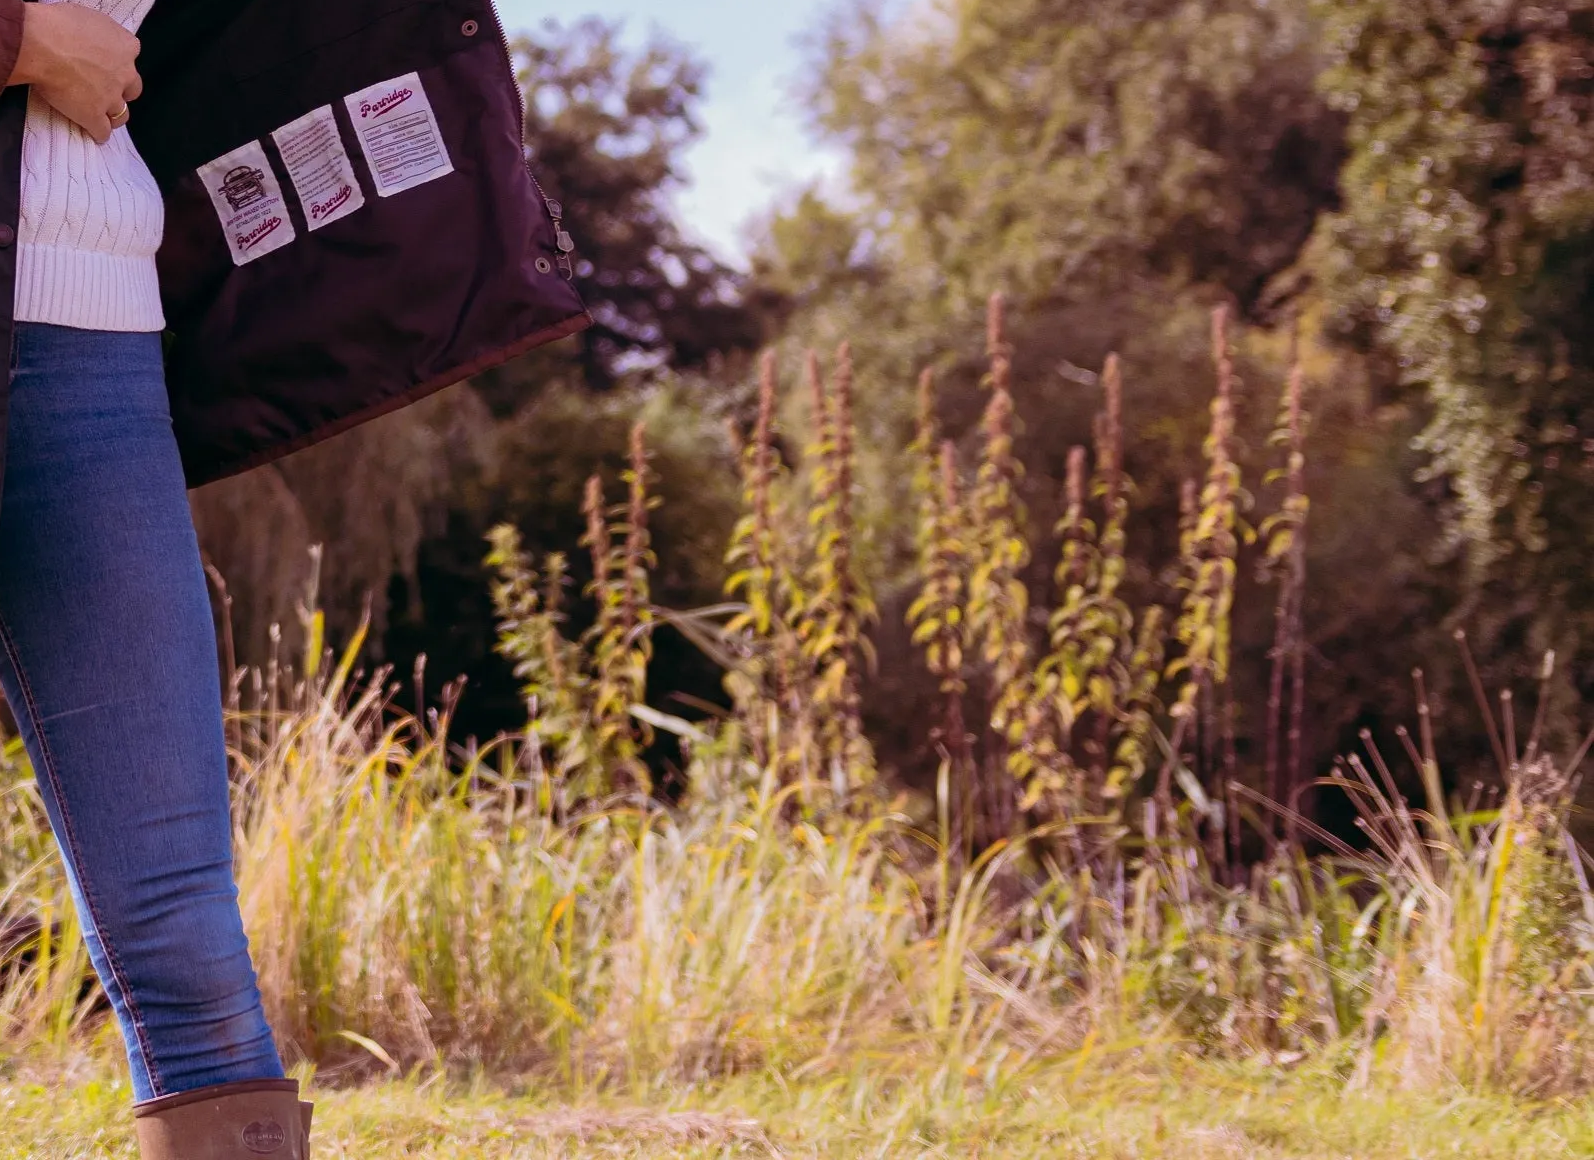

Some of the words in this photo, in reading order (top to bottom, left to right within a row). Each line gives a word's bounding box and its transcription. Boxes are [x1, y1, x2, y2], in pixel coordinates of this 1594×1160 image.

[361, 87, 412, 119] Partridge
[311, 184, 352, 220] Partridge
[237, 216, 281, 251] Partridge
